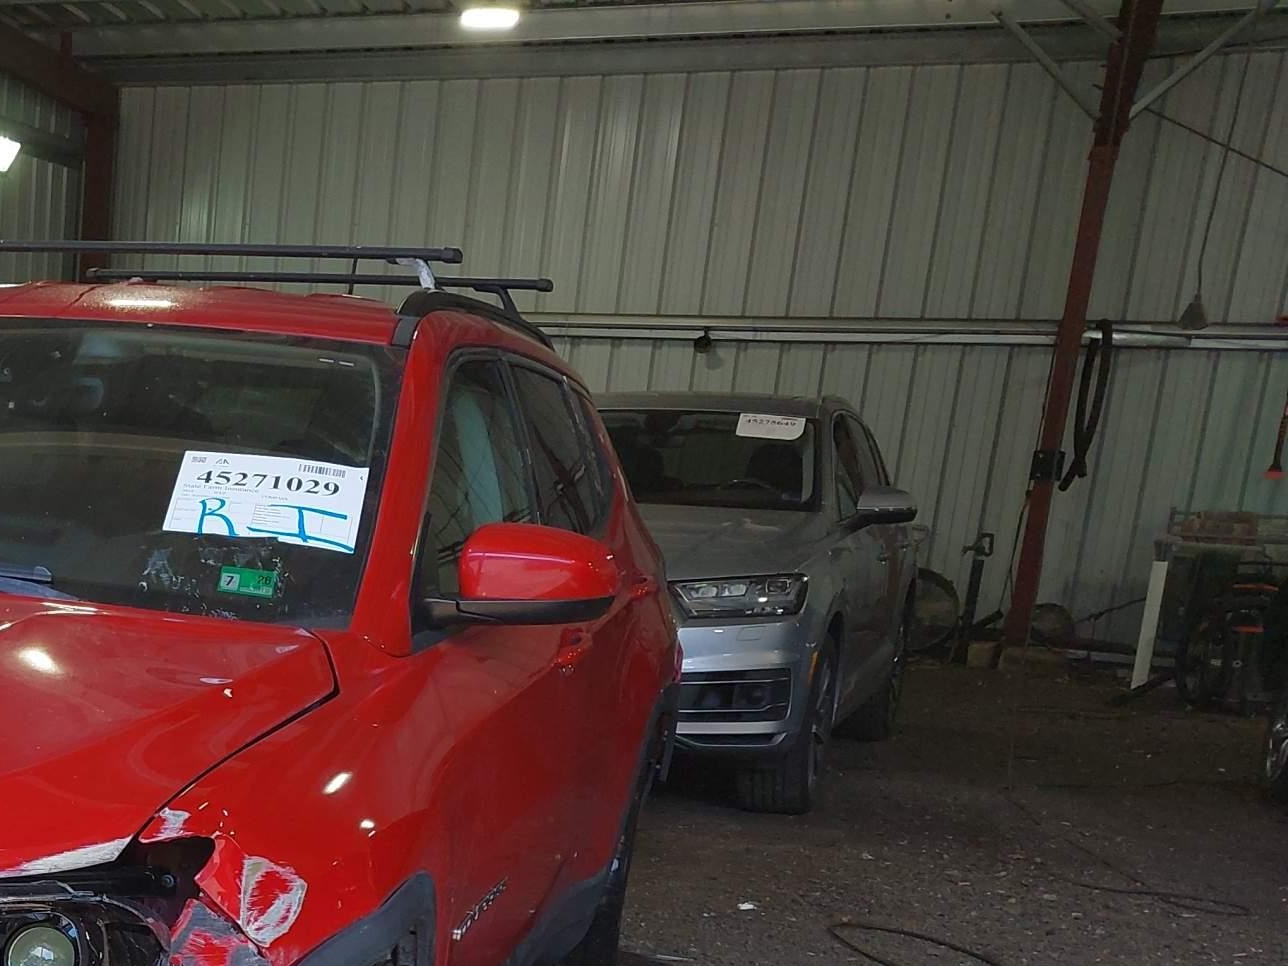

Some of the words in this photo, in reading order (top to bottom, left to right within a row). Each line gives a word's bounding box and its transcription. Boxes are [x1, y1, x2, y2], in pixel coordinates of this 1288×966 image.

[196, 470, 341, 496] 45271029
[198, 498, 240, 536] R
[225, 575, 235, 586] 7
